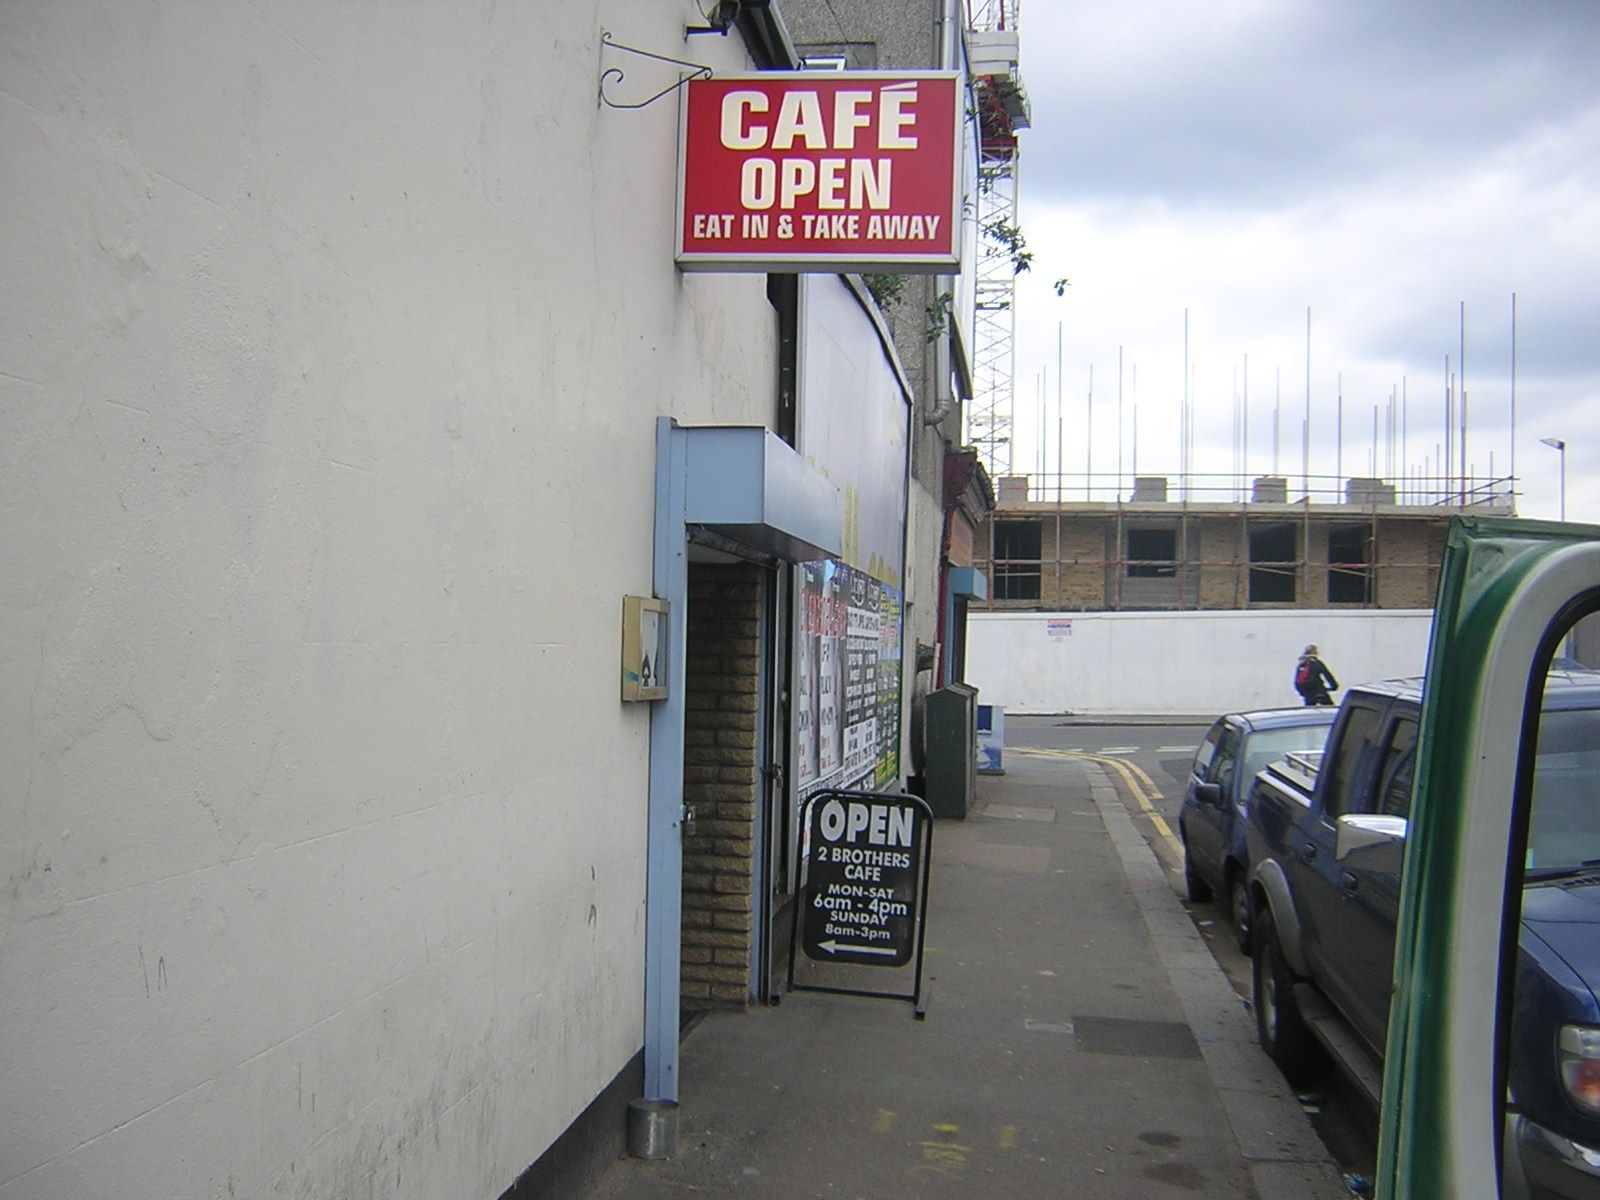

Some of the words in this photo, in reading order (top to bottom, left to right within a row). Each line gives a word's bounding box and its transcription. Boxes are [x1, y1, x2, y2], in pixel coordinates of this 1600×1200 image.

[720, 81, 918, 150] CAFÉ
[741, 158, 892, 210] OPEN
[693, 214, 735, 240] EAT
[742, 214, 769, 240] IN
[777, 214, 794, 240] &
[801, 214, 859, 240] TAKE
[867, 215, 940, 240] AWAY
[820, 799, 914, 847] OPEN
[818, 846, 828, 861] 2
[832, 847, 910, 868] BROTHERS
[845, 866, 881, 882] CAFE
[828, 884, 894, 899] MON-SAT
[814, 893, 852, 910] 6am
[868, 898, 907, 917] 4pm
[830, 910, 888, 926] SUNDAY
[825, 924, 891, 941] 8am-3pm
